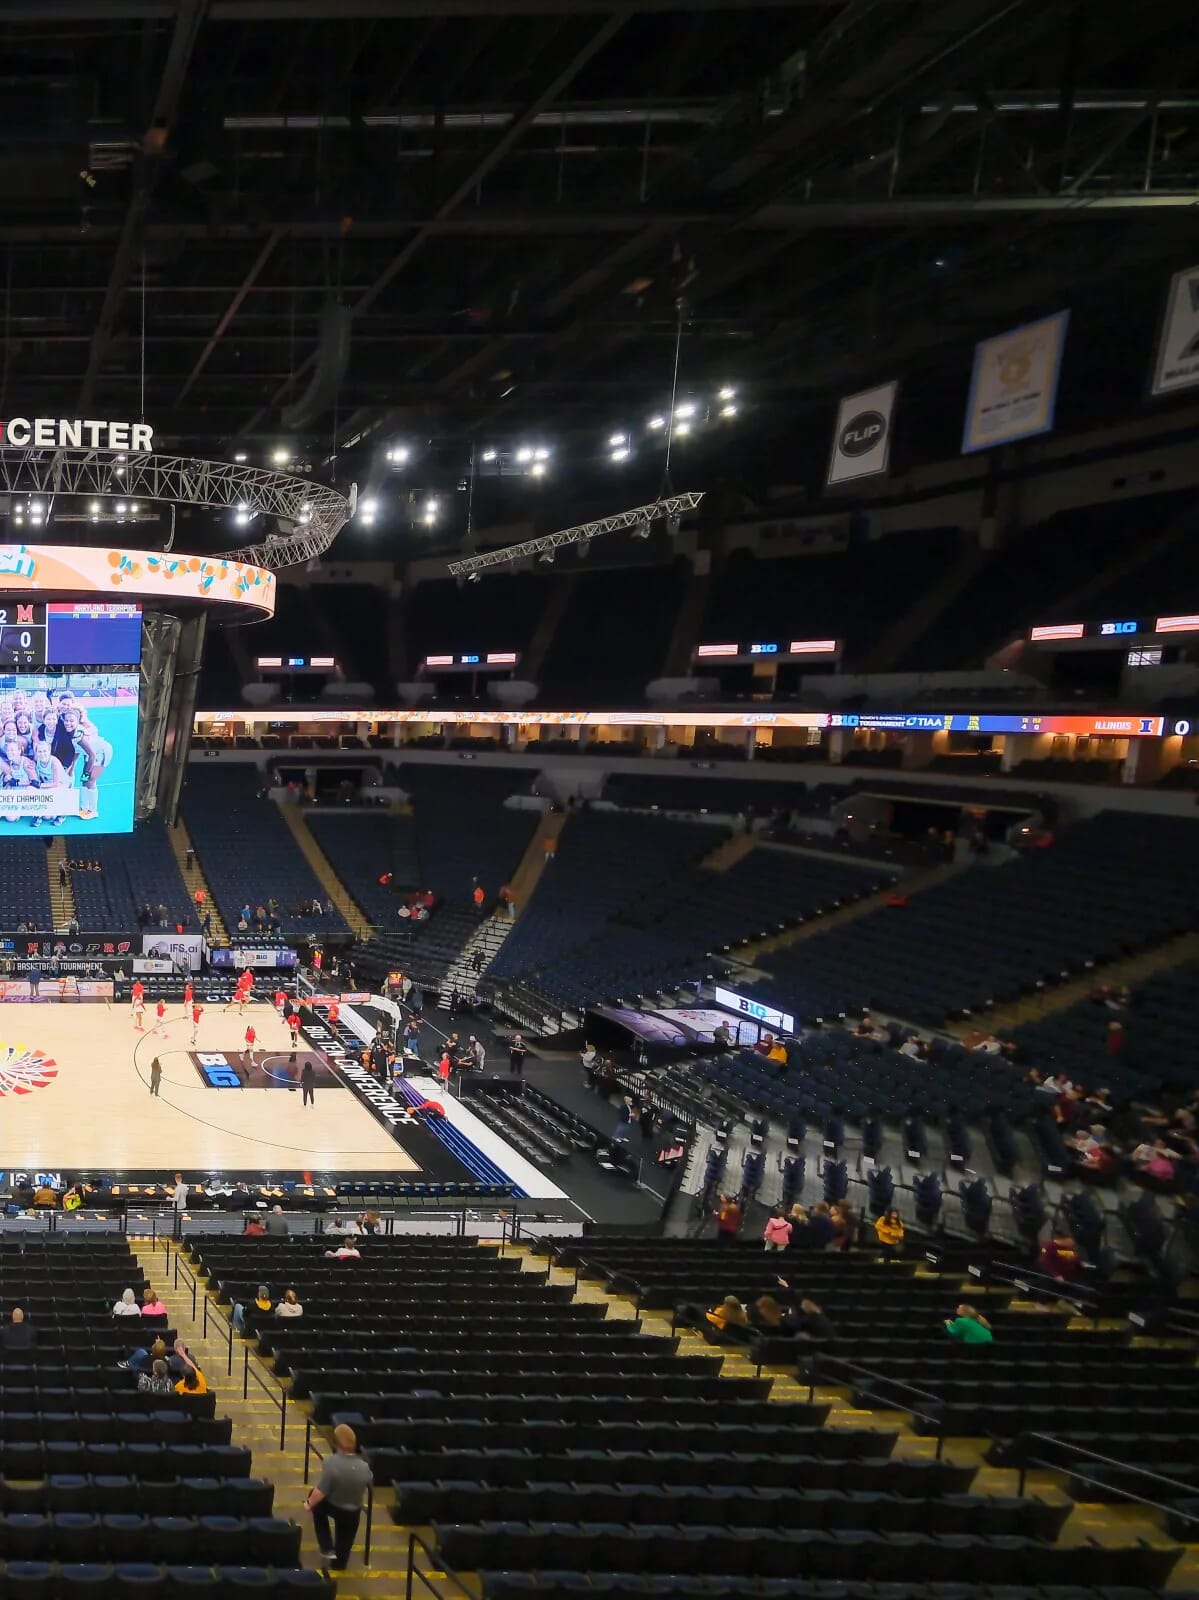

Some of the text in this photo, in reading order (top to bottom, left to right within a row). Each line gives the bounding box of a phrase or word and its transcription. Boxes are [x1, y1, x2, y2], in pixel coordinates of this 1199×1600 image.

[7, 418, 154, 451] CENTER
[844, 424, 881, 445] FLIP
[16, 604, 34, 625] M
[20, 631, 31, 648] 0
[918, 718, 943, 727] TIAA
[1094, 721, 1132, 731] ILLINOIS
[1174, 720, 1190, 735] 0
[16, 794, 54, 803] CHAMPIONS
[60, 962, 103, 971] TOURNAMENT
[302, 1025, 420, 1126] BIG TEN CONFERENCE
